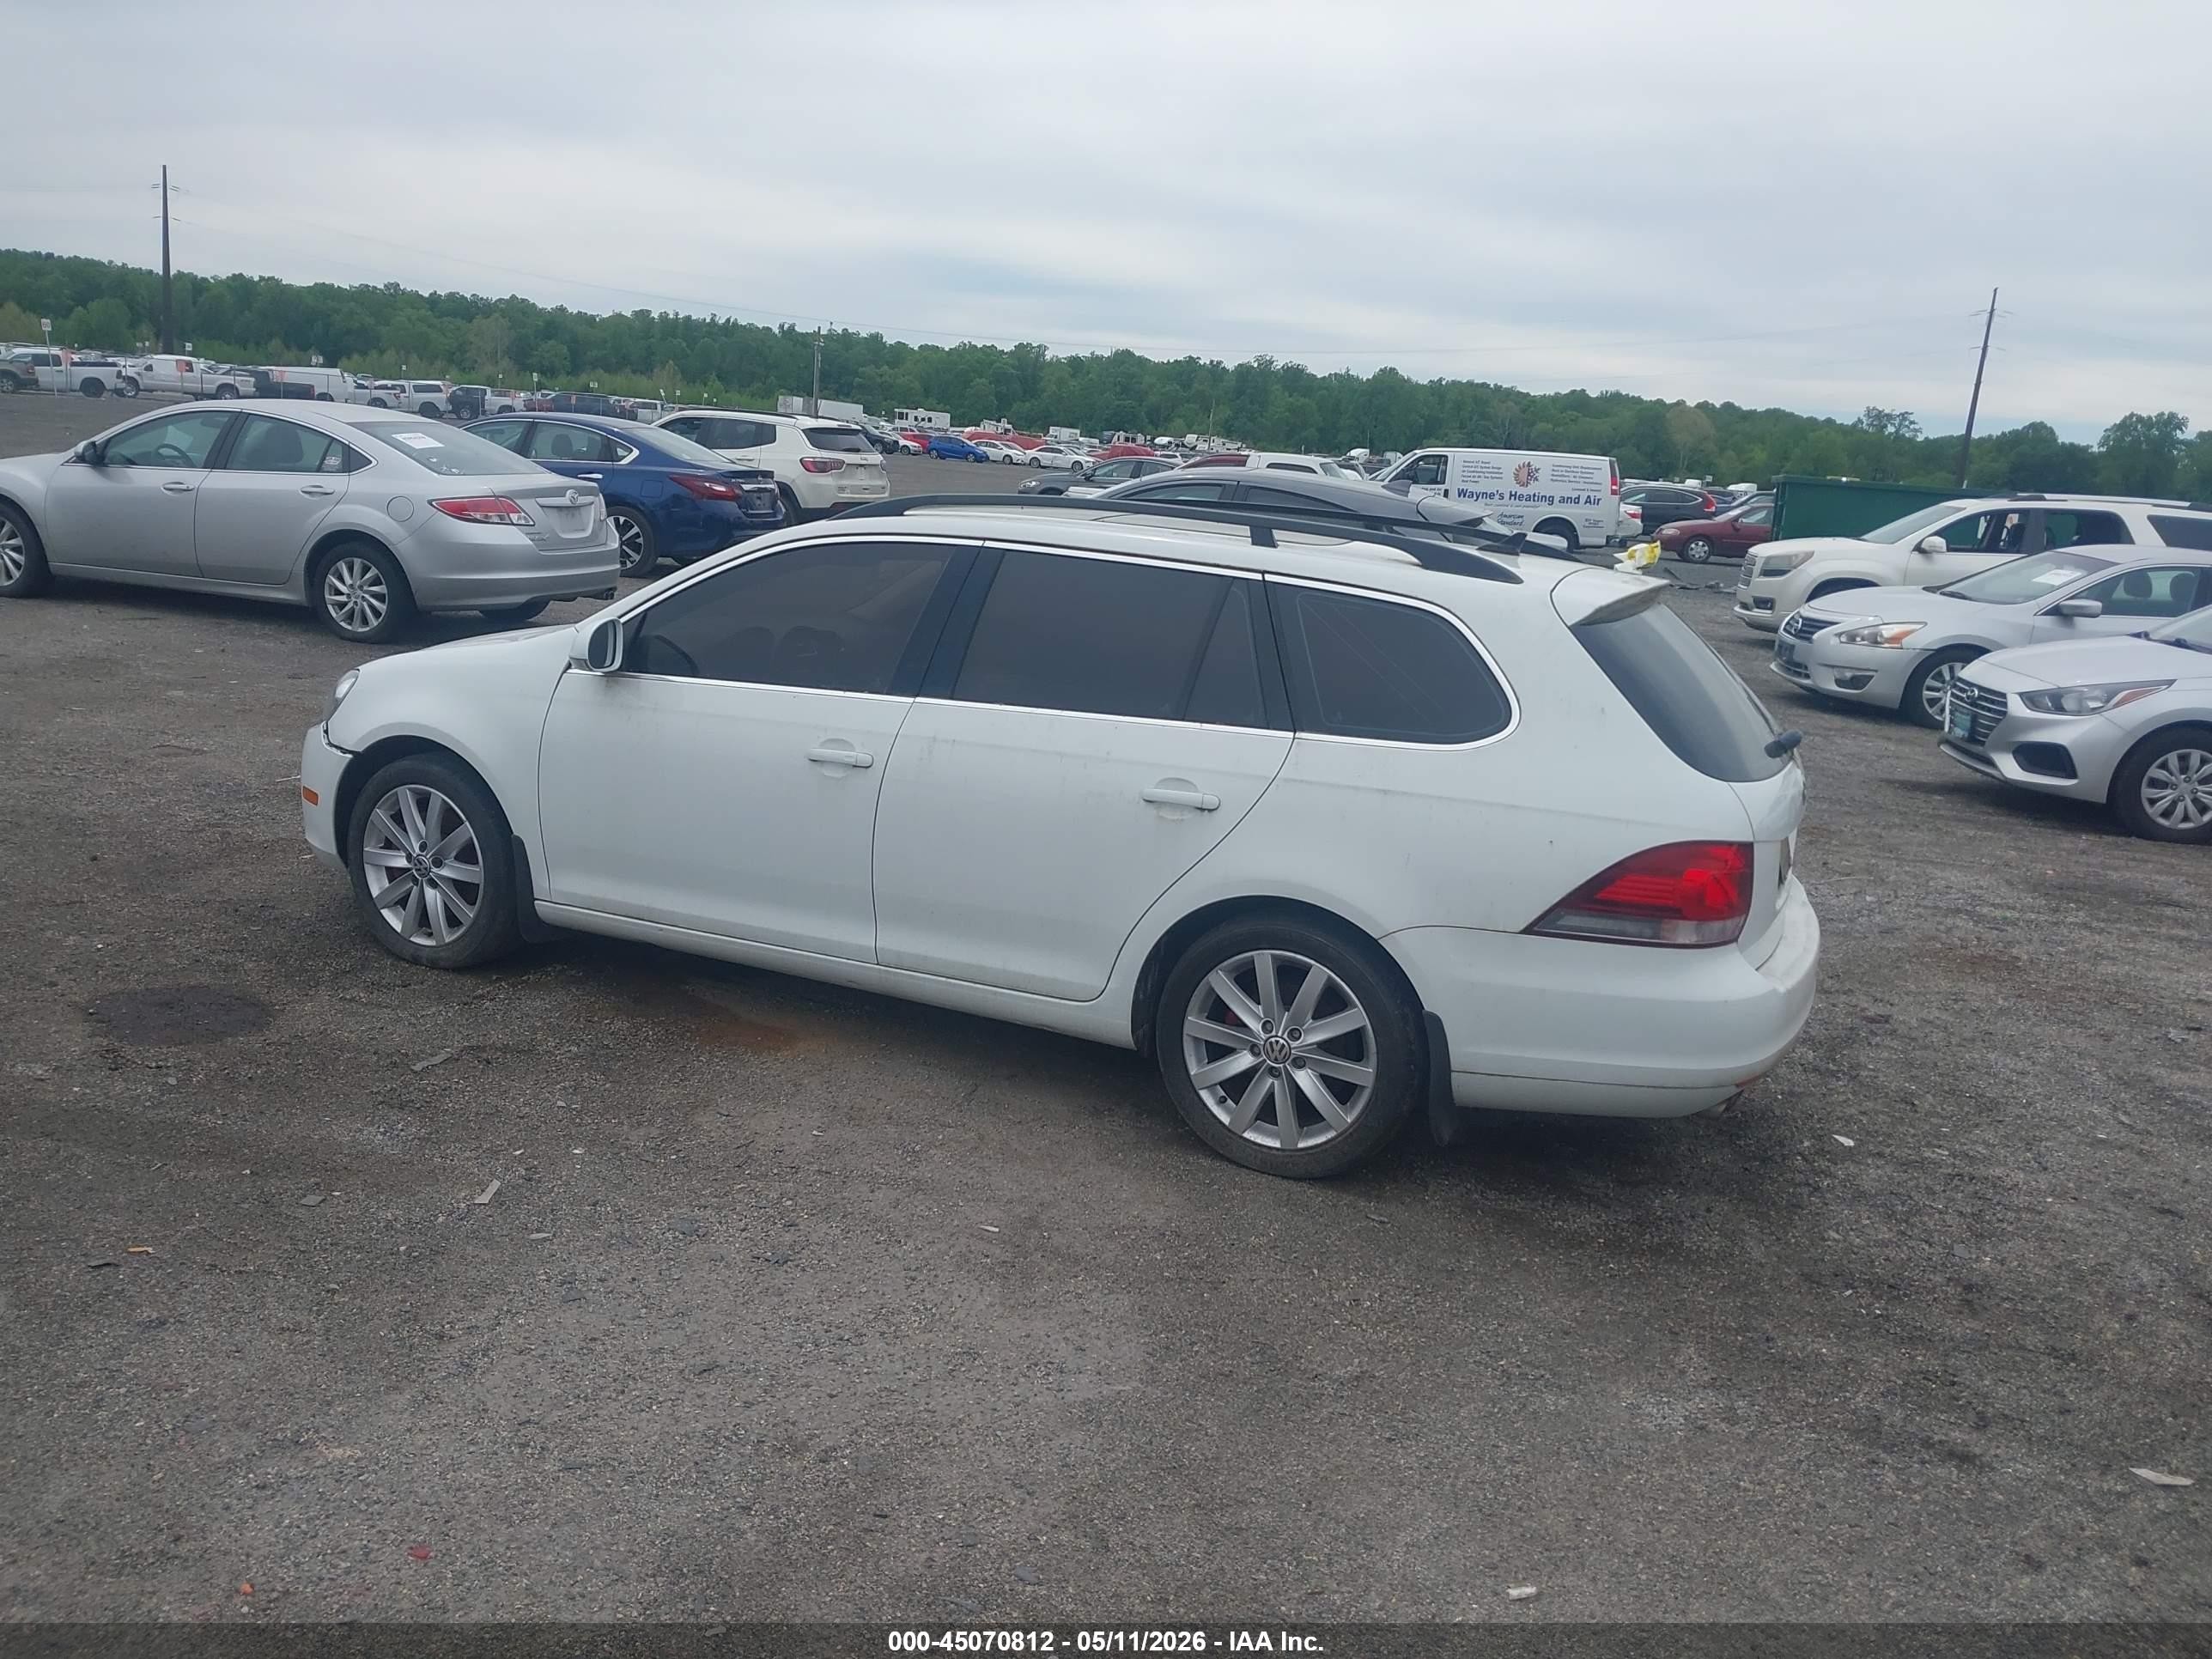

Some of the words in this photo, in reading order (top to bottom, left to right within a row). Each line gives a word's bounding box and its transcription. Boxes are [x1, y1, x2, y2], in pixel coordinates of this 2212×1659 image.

[1457, 487, 1504, 501] Wayne's
[1509, 490, 1554, 506] Heating
[1559, 495, 1581, 505] and
[1584, 495, 1602, 506] Air
